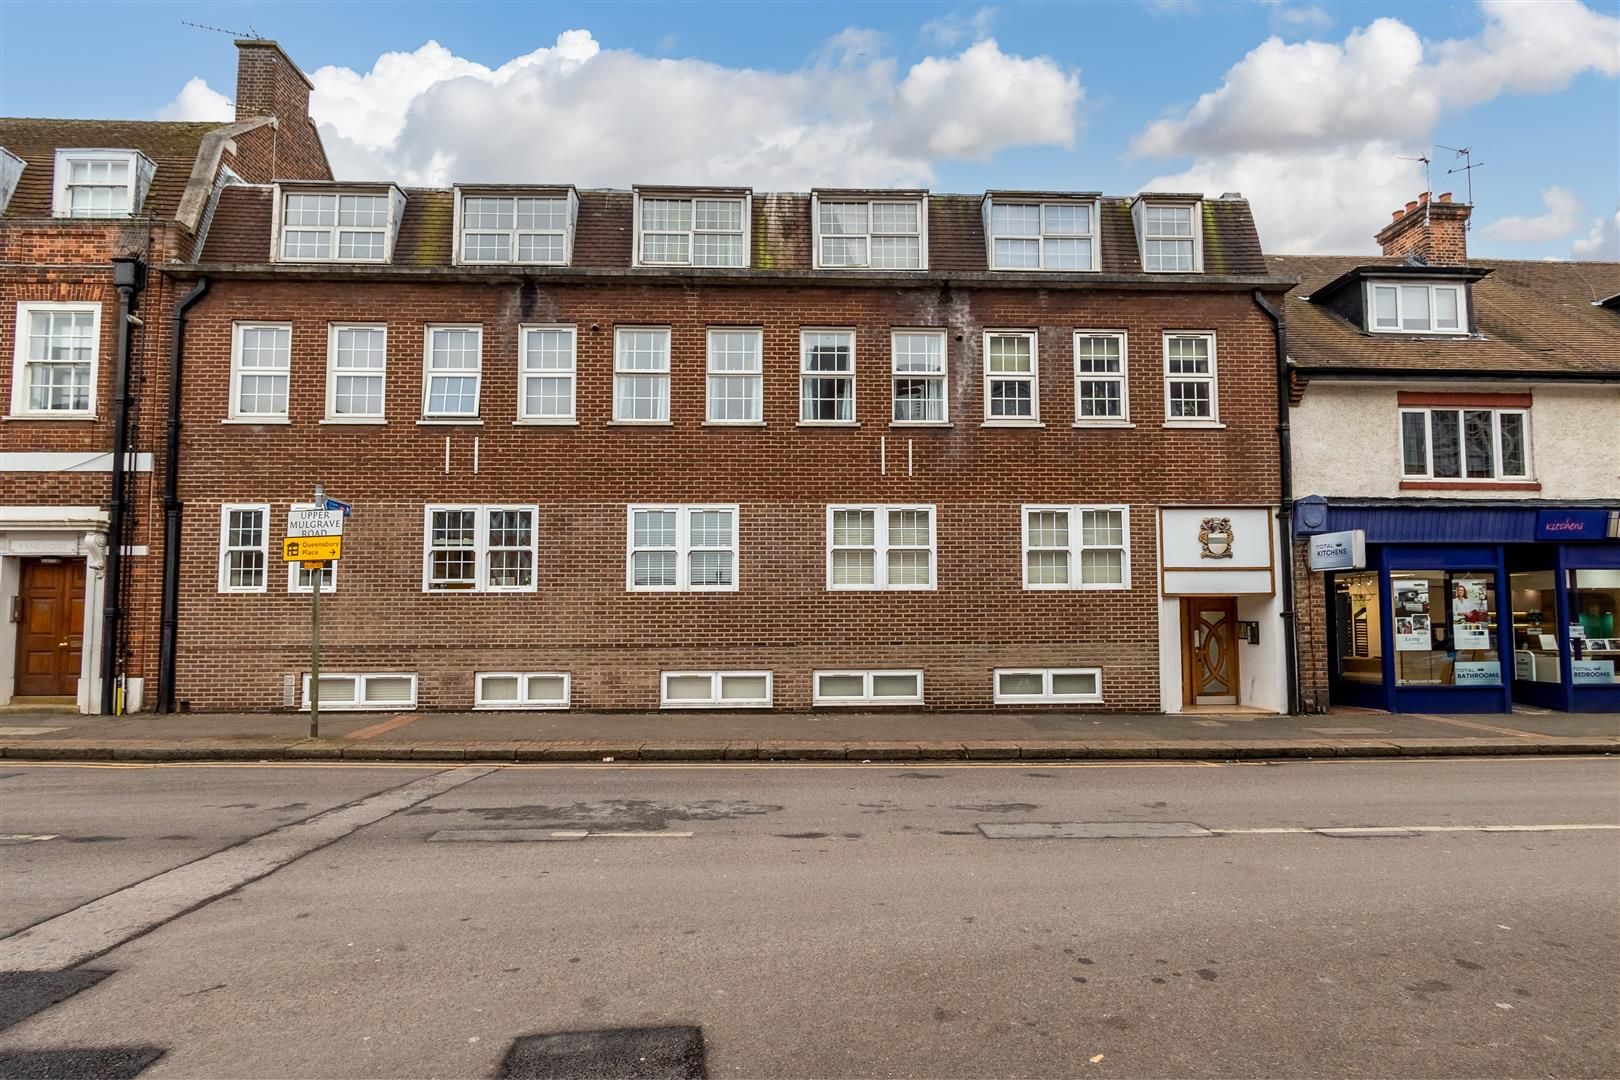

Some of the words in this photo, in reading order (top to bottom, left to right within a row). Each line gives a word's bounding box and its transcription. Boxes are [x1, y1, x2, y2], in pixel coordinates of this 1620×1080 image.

[290, 520, 340, 528] MULGRAVE
[1545, 518, 1584, 531] kitchens
[1317, 548, 1347, 556] KITCHENS
